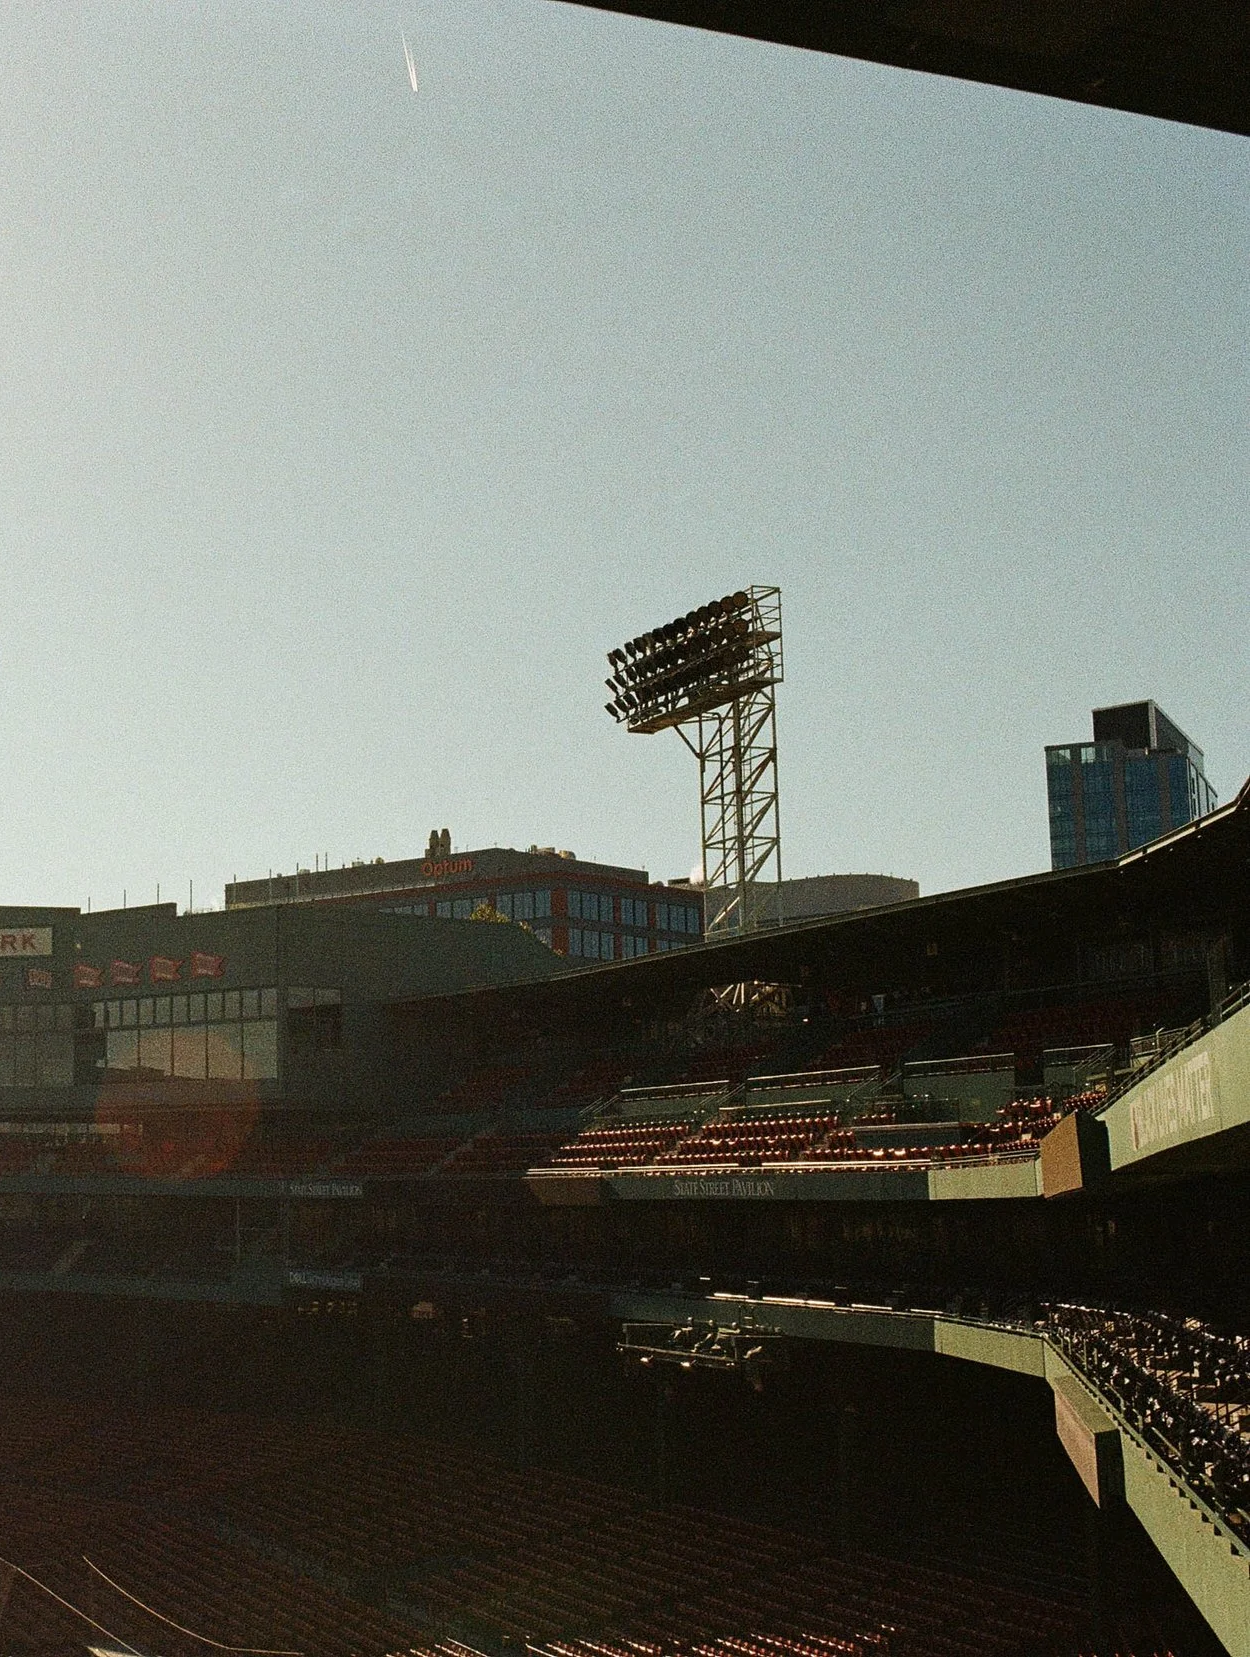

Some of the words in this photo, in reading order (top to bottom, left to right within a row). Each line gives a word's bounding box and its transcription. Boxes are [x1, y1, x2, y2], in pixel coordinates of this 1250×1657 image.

[421, 859, 473, 877] Optum
[1175, 1051, 1214, 1126] MATTER
[674, 1179, 698, 1196] STATE
[700, 1178, 730, 1196] STREET
[732, 1178, 774, 1197] PAVILION
